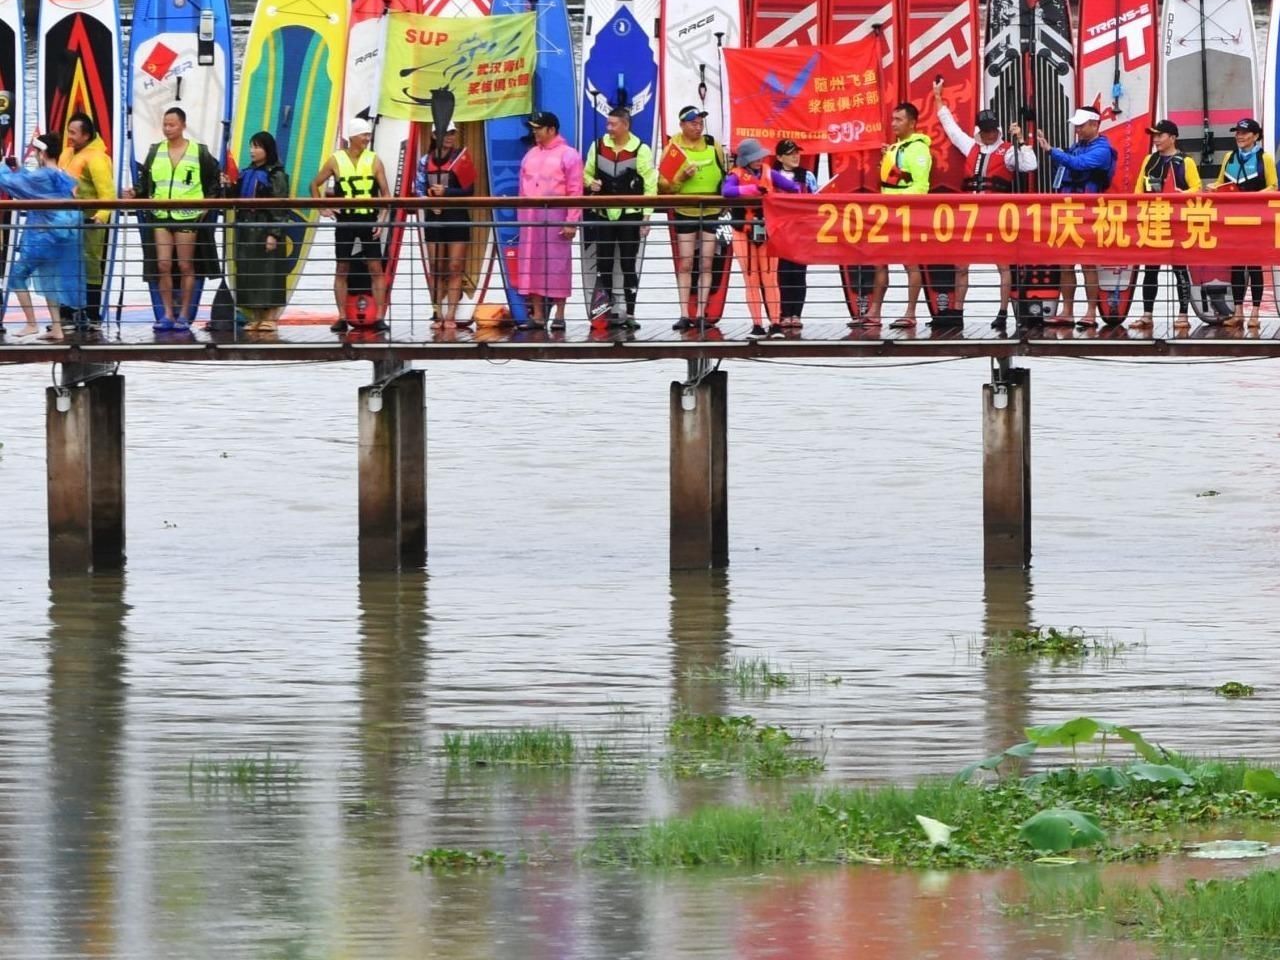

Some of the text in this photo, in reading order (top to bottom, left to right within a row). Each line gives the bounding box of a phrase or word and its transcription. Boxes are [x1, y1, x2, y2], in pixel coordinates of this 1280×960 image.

[678, 14, 715, 37] RACE
[405, 29, 448, 46] SUP
[355, 48, 378, 66] RAC
